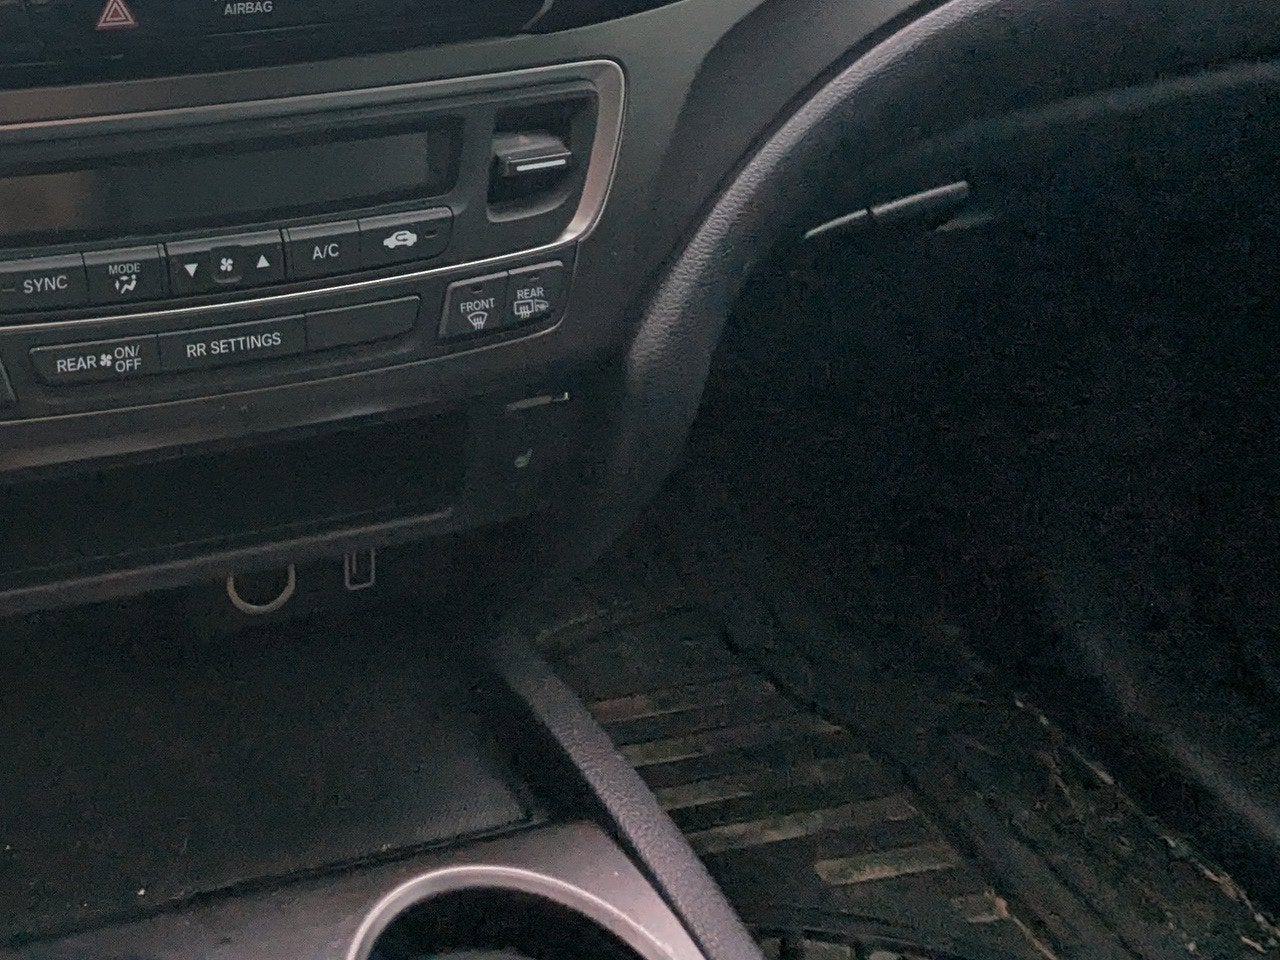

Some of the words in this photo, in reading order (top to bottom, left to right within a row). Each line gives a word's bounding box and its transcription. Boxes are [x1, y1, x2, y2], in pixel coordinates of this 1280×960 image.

[224, 1, 273, 15] AIRBAG
[312, 243, 340, 261] A/C
[108, 262, 141, 275] MODE
[23, 275, 68, 294] SYNC
[516, 287, 545, 300] REAR
[460, 297, 496, 313] FRONT
[186, 343, 207, 358] RR
[210, 332, 282, 355] SETTINGS
[56, 355, 97, 373] REAR
[115, 357, 142, 373] OFF
